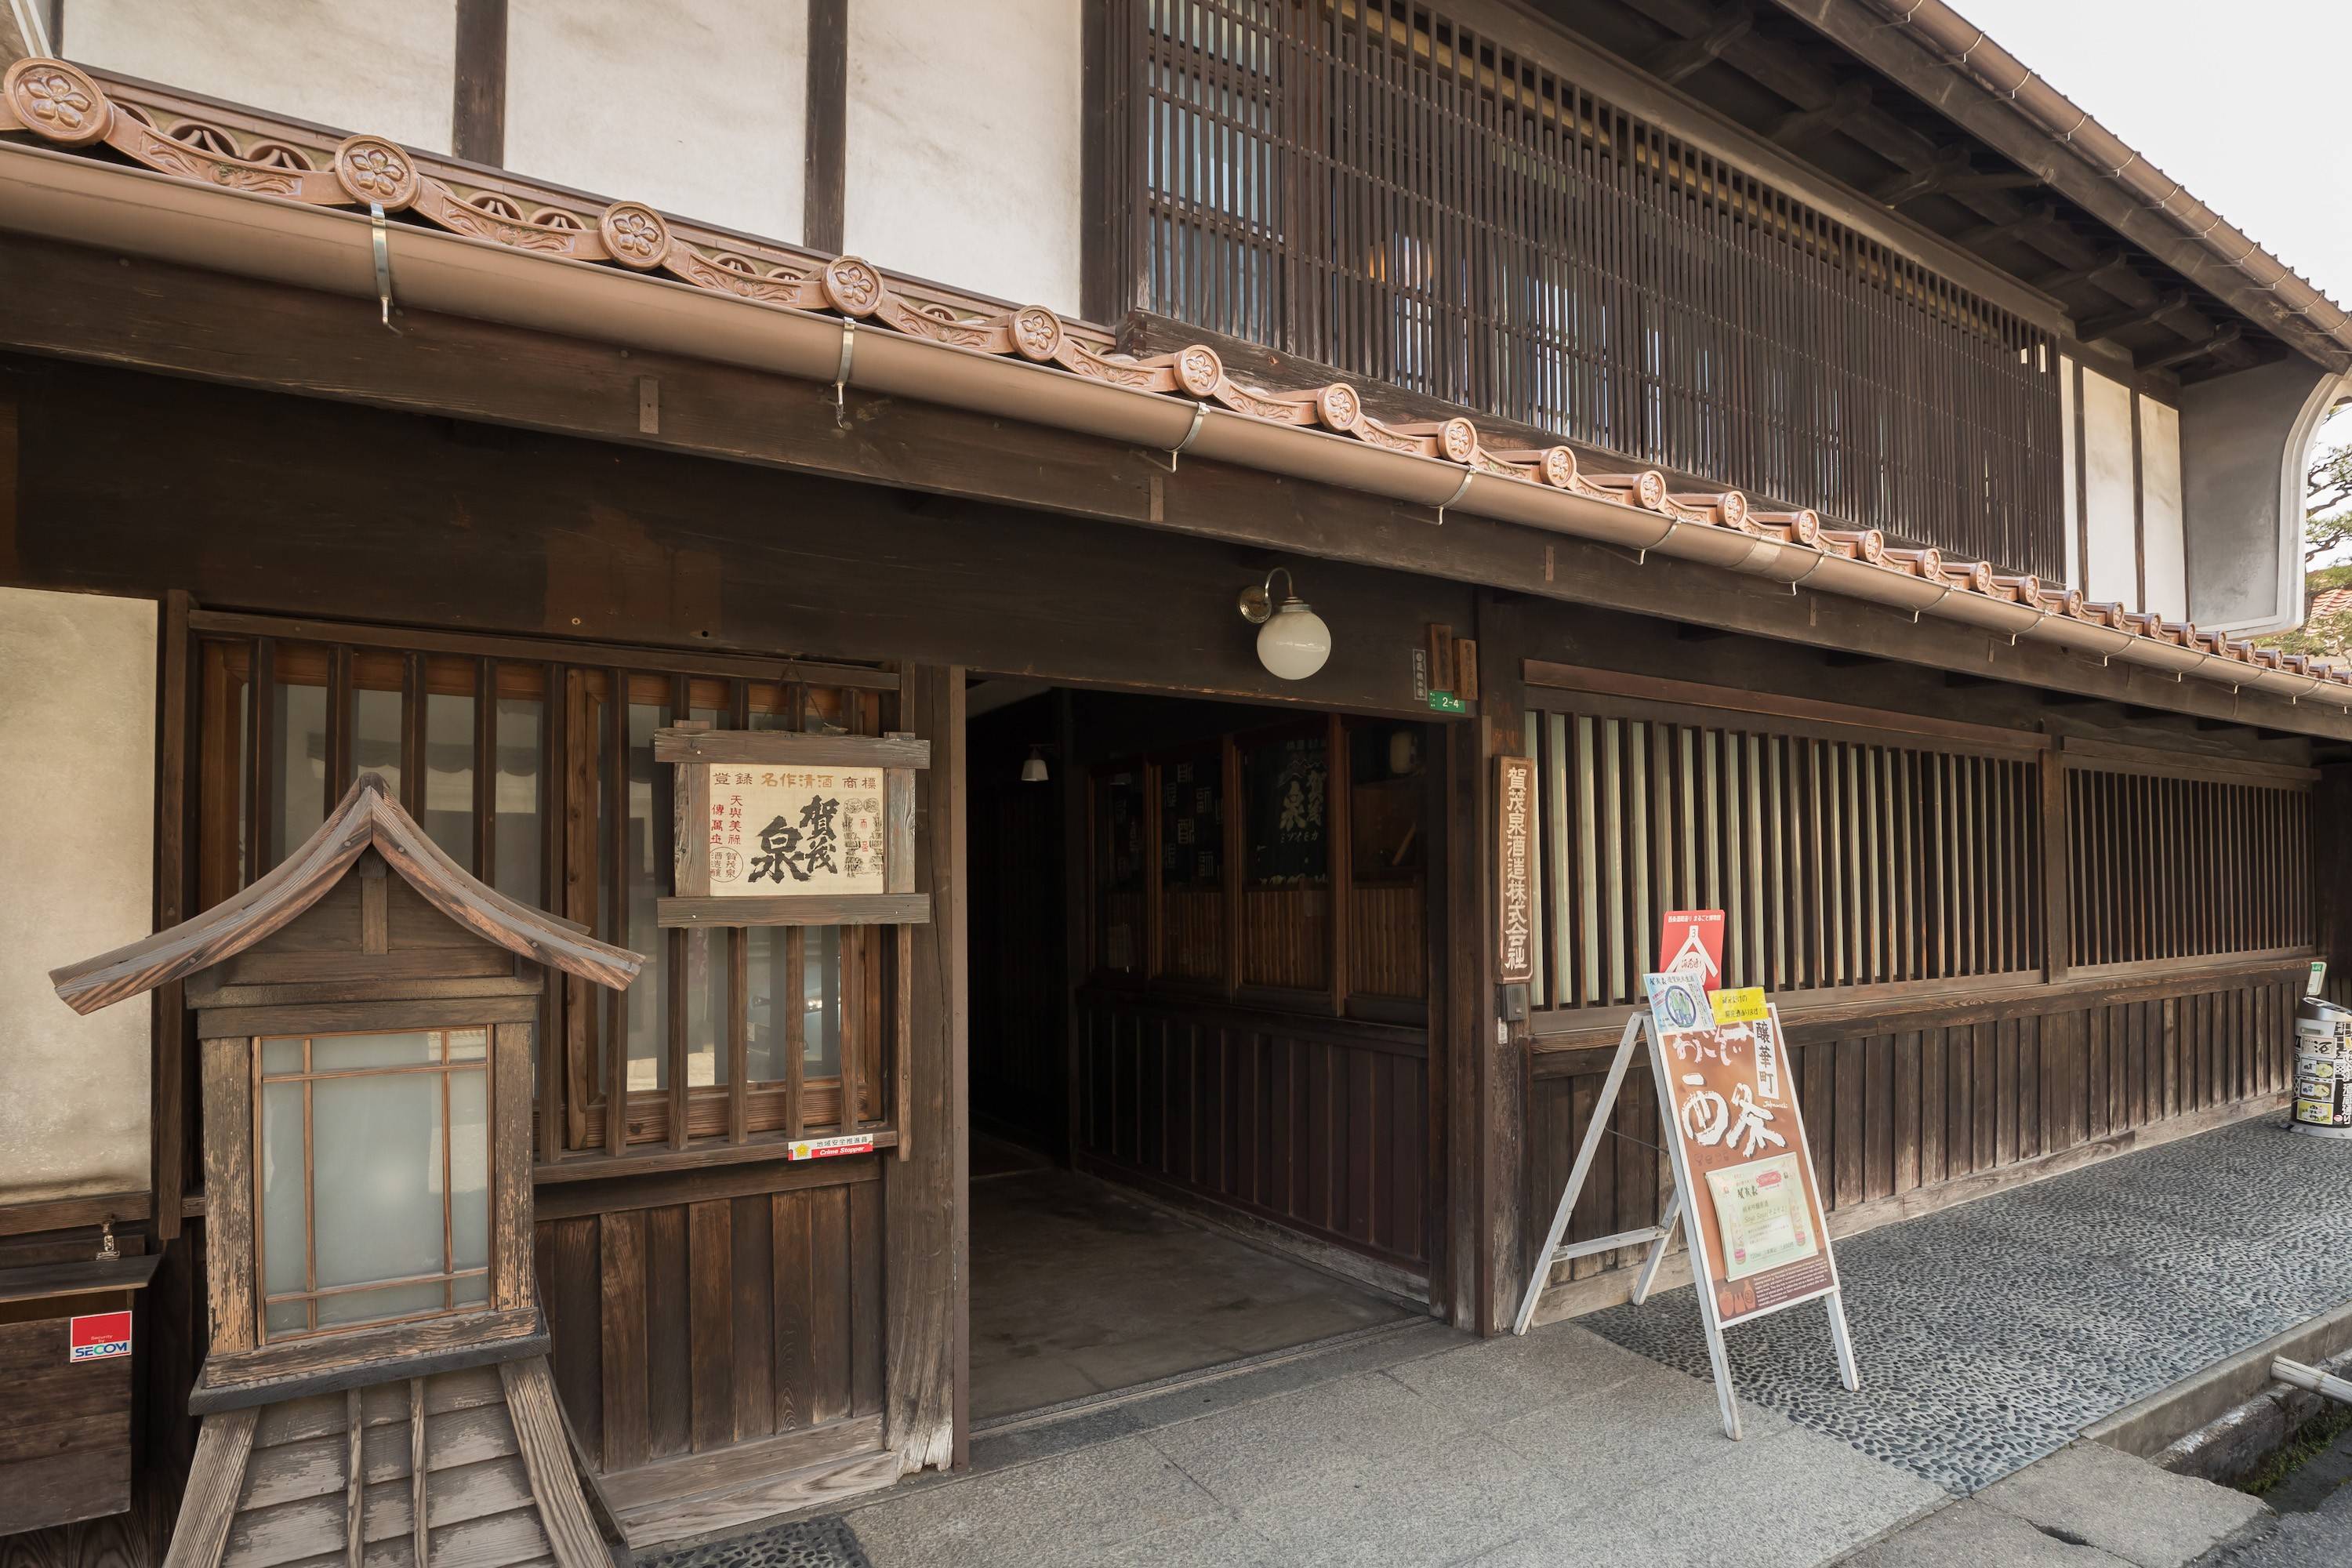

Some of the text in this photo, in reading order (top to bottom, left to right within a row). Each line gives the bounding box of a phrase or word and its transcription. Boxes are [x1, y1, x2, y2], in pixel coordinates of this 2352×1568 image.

[1442, 696, 1459, 709] 2-4
[1504, 766, 1529, 971] 賀茂泉酒造株式会社
[1691, 928, 1697, 938] 3
[816, 1135, 868, 1148] 地域安全推進員
[74, 1341, 128, 1358] SECOM
